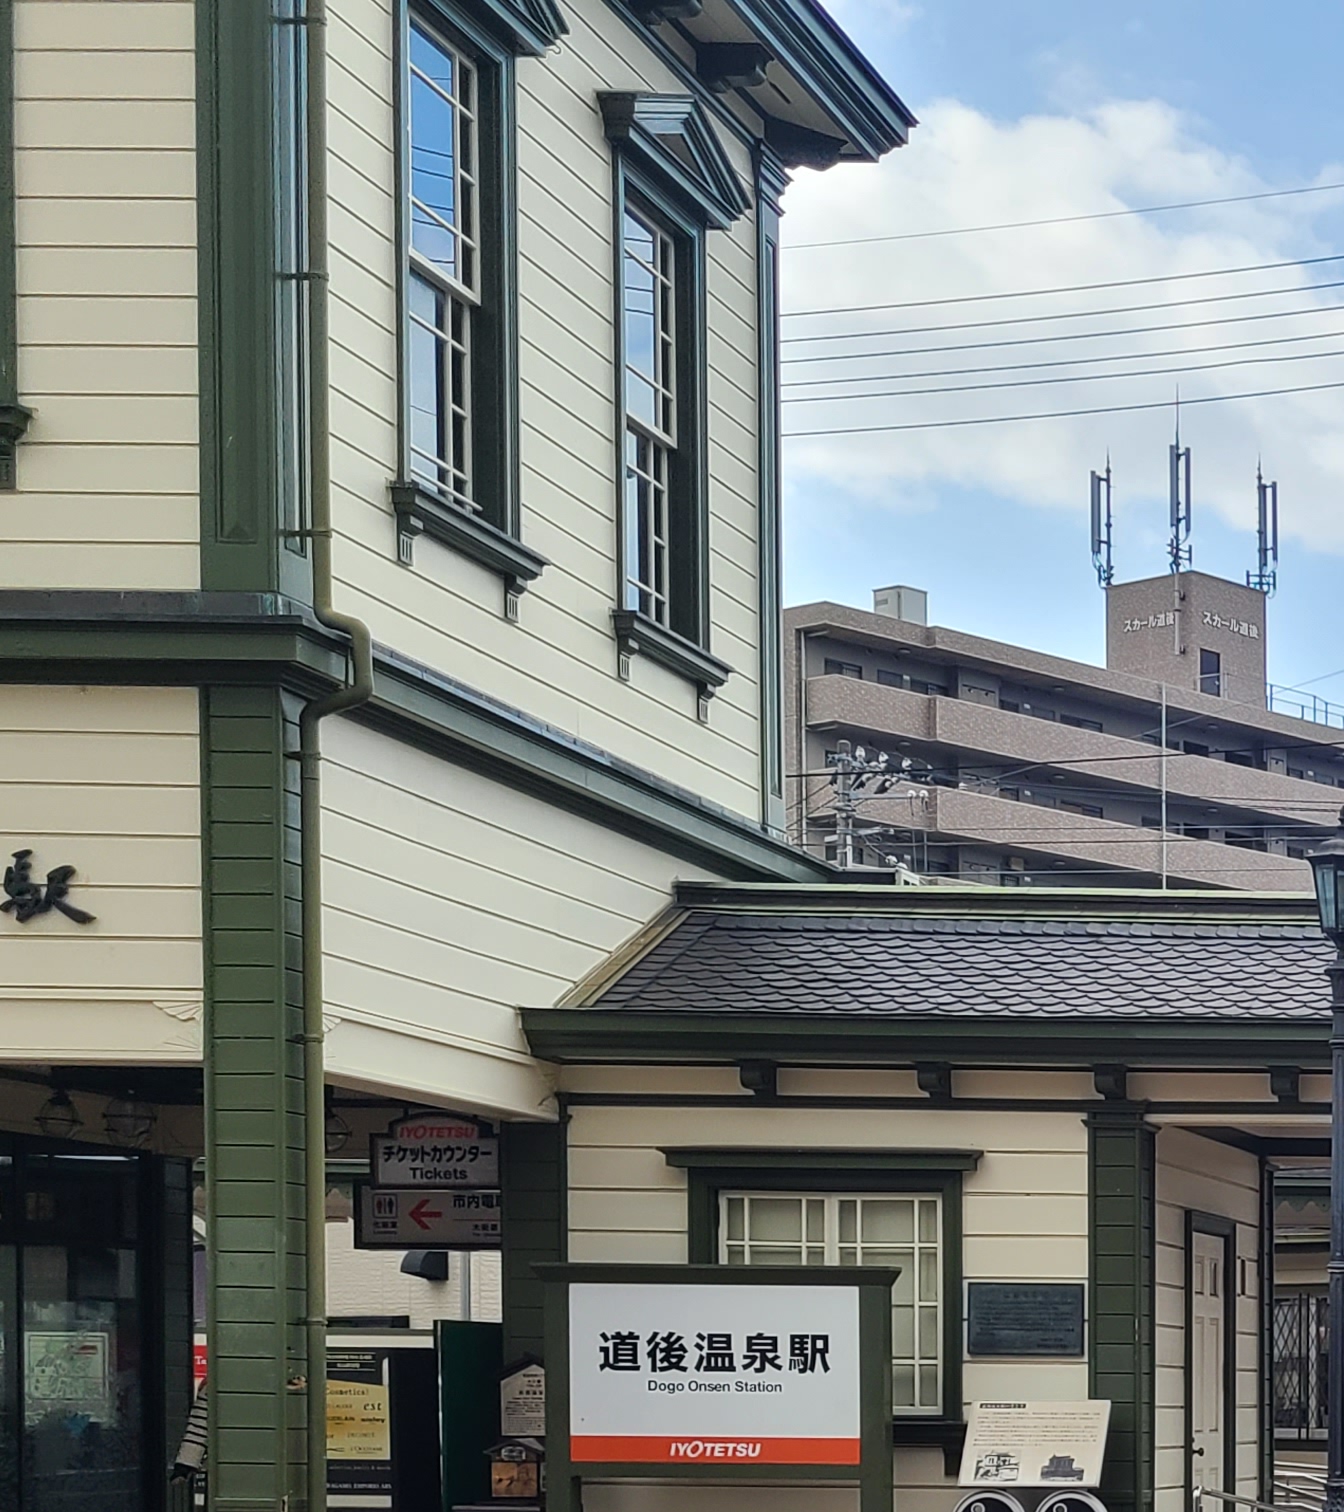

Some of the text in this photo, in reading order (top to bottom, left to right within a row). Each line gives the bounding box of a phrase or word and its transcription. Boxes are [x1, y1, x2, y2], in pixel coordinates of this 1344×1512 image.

[1203, 611, 1259, 639] スカール道後
[401, 1125, 476, 1140] IYOTETSU
[383, 1145, 492, 1163] チケットカウンター
[410, 1167, 468, 1181] Tickets
[599, 1331, 831, 1374] 道後温泉駅
[648, 1380, 782, 1394] Dogo Onsen Station
[670, 1440, 761, 1458] IYOTETSU
